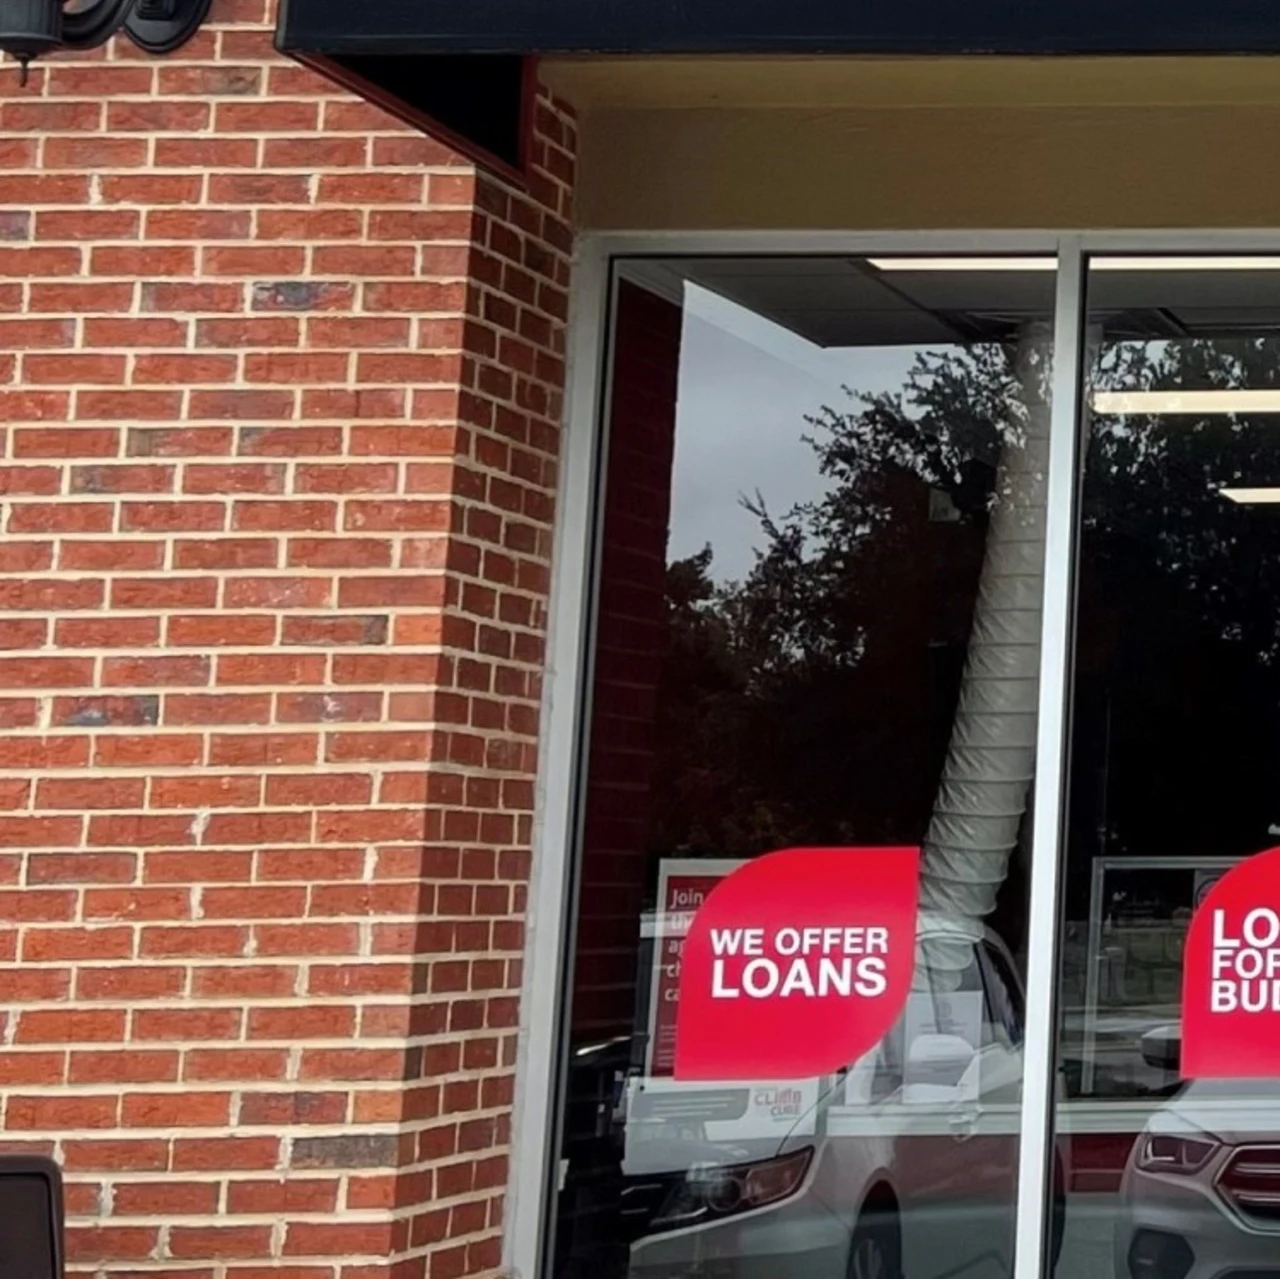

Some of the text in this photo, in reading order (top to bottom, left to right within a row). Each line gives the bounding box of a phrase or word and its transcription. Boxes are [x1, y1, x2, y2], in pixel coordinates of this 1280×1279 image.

[710, 927, 889, 955] WE OFFER
[711, 956, 888, 998] LOANS
